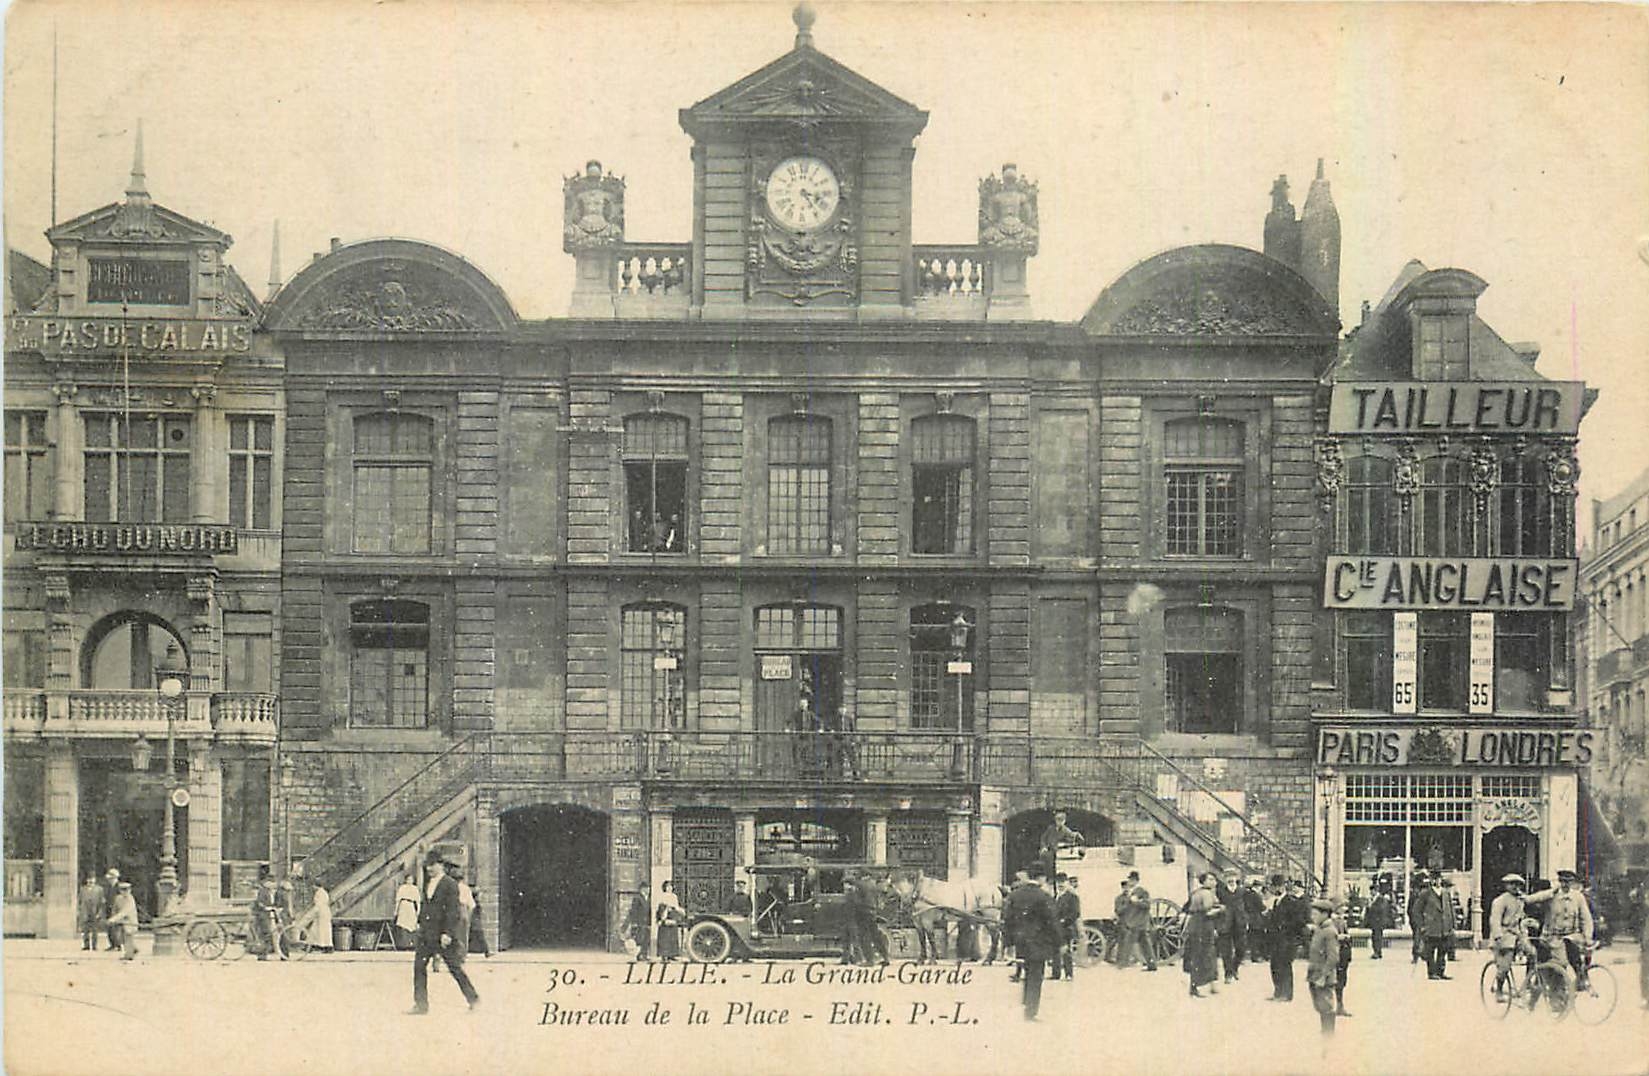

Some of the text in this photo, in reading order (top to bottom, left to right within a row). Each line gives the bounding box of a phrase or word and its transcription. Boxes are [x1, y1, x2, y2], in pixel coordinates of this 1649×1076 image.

[42, 319, 98, 349] PAS
[141, 321, 250, 351] CALAIS
[1351, 386, 1562, 429] TAILLEUR
[116, 526, 151, 549] DU
[159, 525, 236, 550] NORD
[1382, 562, 1568, 607] ANGLAISE
[1320, 731, 1400, 764] PARIS
[1461, 732, 1593, 764] LONDRES
